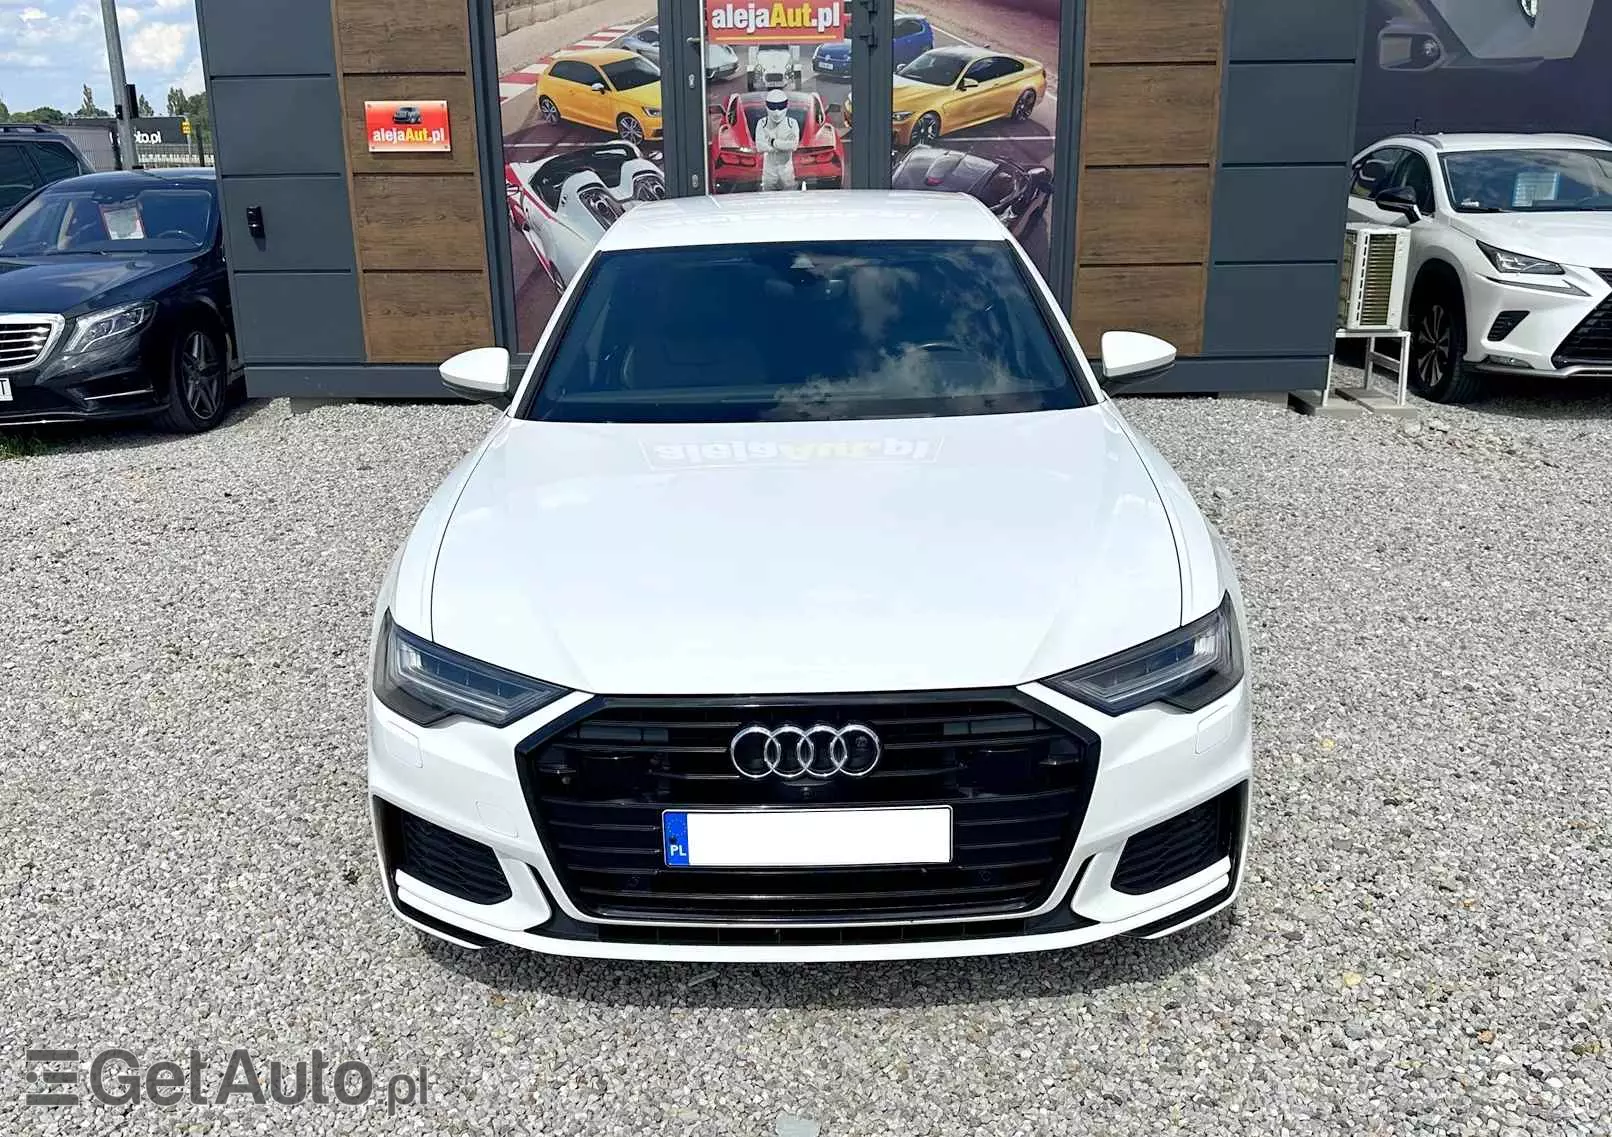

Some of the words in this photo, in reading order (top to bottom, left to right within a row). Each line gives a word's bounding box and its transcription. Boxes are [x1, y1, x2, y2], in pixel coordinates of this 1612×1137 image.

[711, 2, 840, 33] alejaAut.pl
[373, 127, 444, 144] alejaAut.pl
[670, 845, 686, 857] PL
